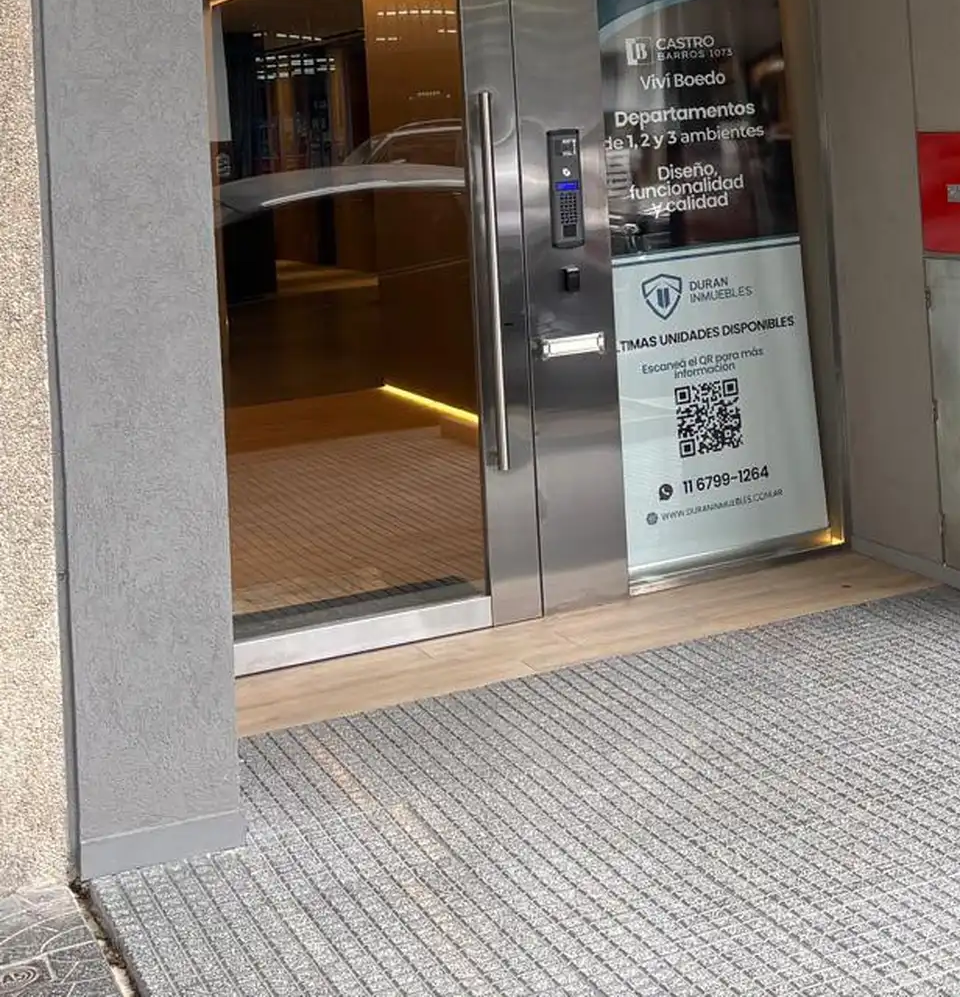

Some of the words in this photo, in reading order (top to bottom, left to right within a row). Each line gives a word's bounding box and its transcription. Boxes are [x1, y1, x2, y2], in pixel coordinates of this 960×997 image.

[656, 34, 715, 51] CASTRO
[656, 49, 705, 62] BARROS
[709, 47, 733, 58] 1073
[673, 70, 726, 88] Boedo
[614, 102, 756, 130] Departamentos
[603, 136, 624, 151] de
[653, 134, 664, 150] y
[667, 129, 677, 145] 3
[680, 124, 765, 145] ambientes
[657, 162, 719, 182] Diseño,
[629, 173, 745, 200] funcionalidad
[665, 191, 729, 213] calidad
[688, 276, 730, 292] DURAN
[688, 285, 754, 304] INMUEBLES
[660, 326, 720, 347] UNIDADES
[722, 314, 796, 338] DISPONIBLES
[687, 354, 698, 368] el
[699, 352, 714, 366] QR
[715, 349, 740, 365] para
[740, 346, 765, 359] más
[673, 361, 736, 380] información
[682, 479, 693, 494] 11
[696, 465, 770, 491] 6799-1264
